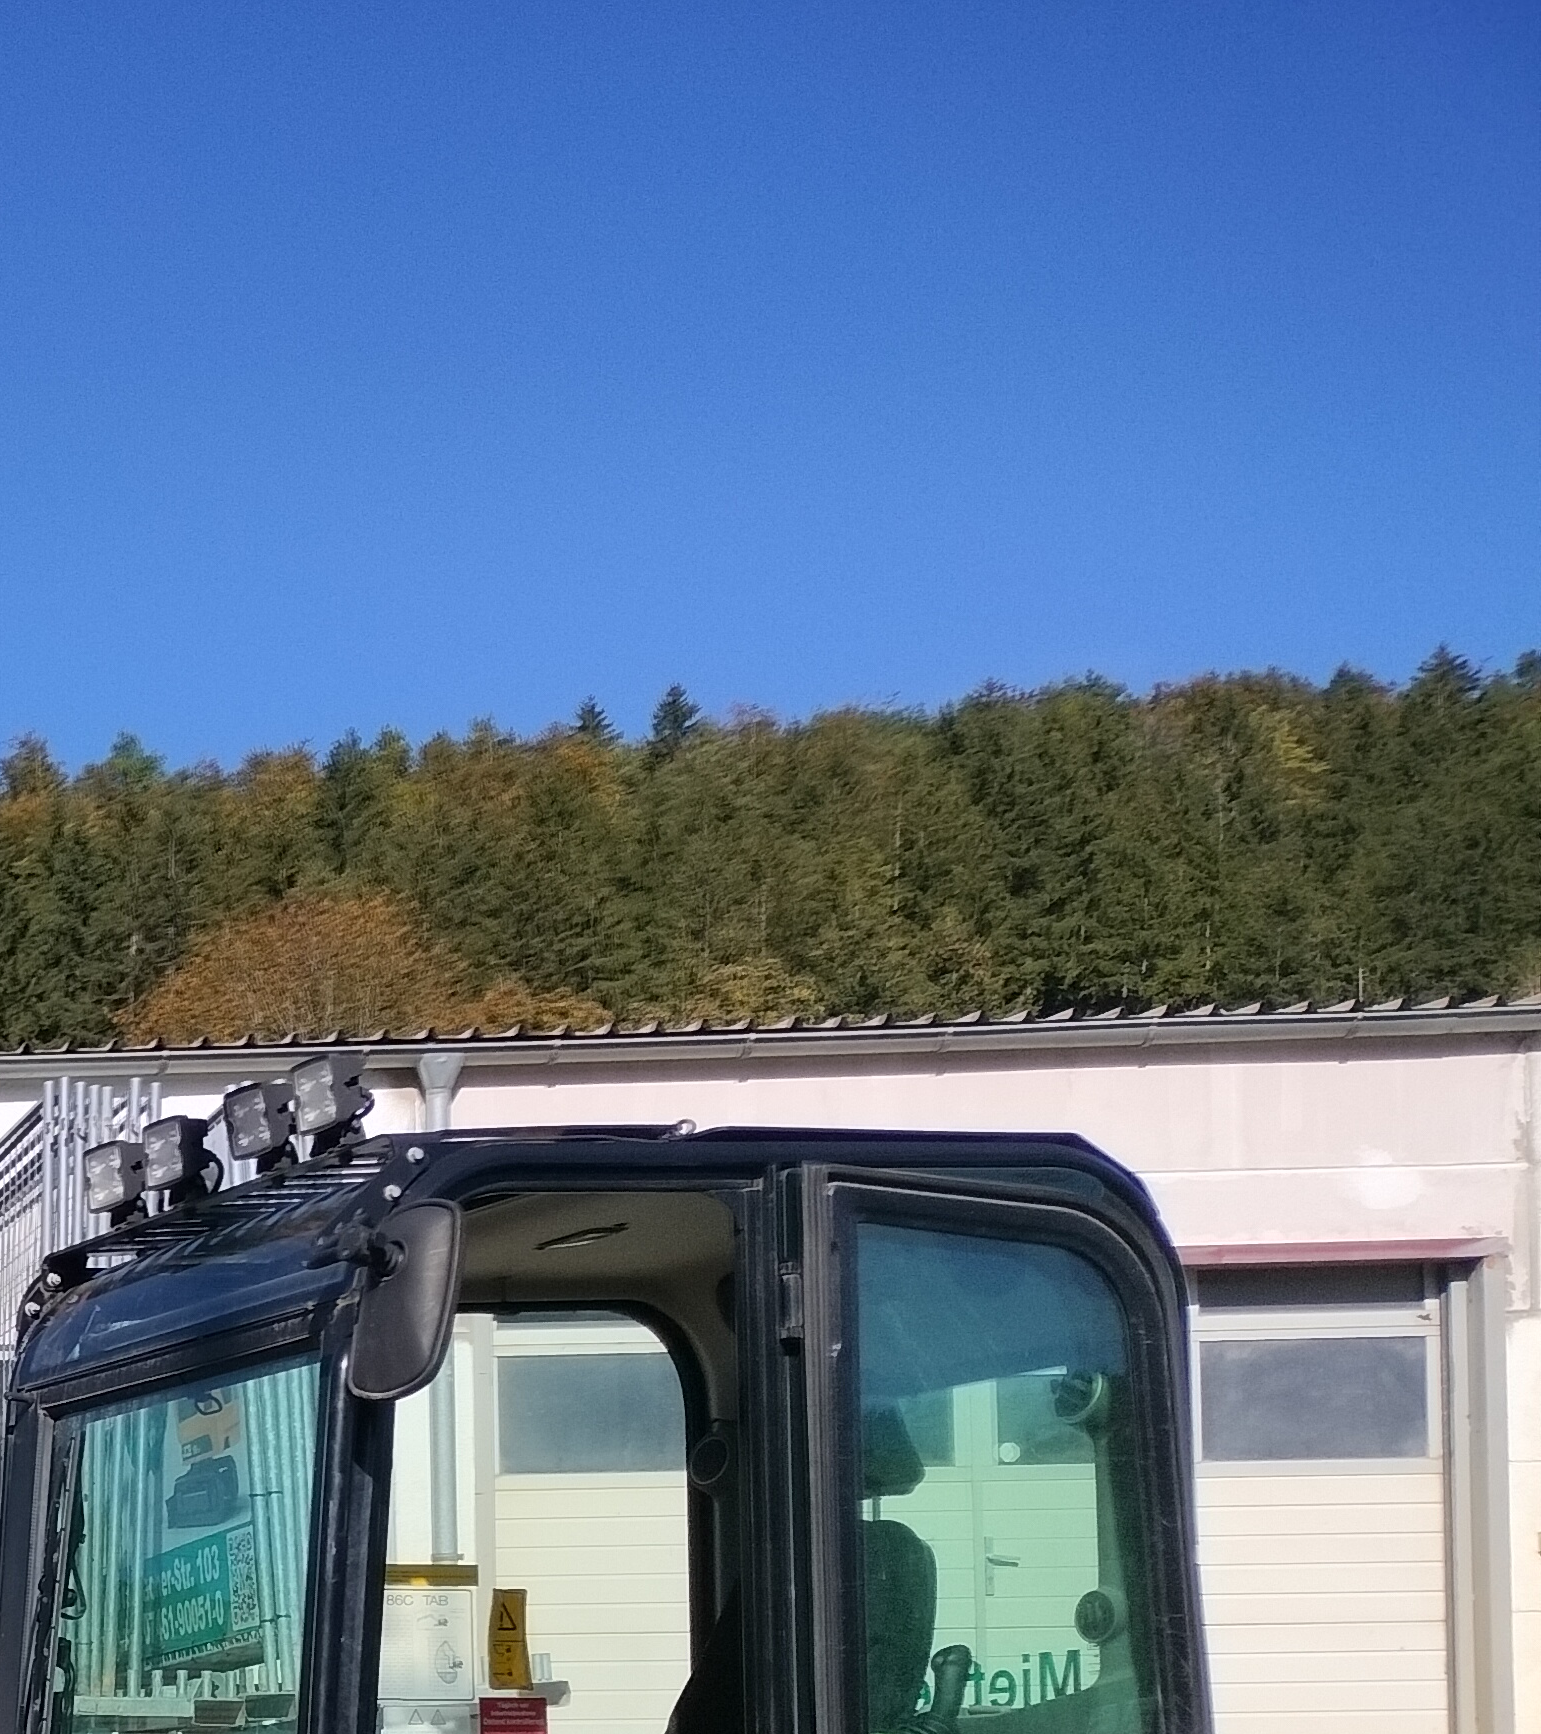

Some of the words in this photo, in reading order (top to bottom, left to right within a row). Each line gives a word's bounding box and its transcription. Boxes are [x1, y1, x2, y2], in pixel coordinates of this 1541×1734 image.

[196, 1544, 220, 1585] 103
[386, 1594, 414, 1606] 86C
[422, 1594, 449, 1606] TAB
